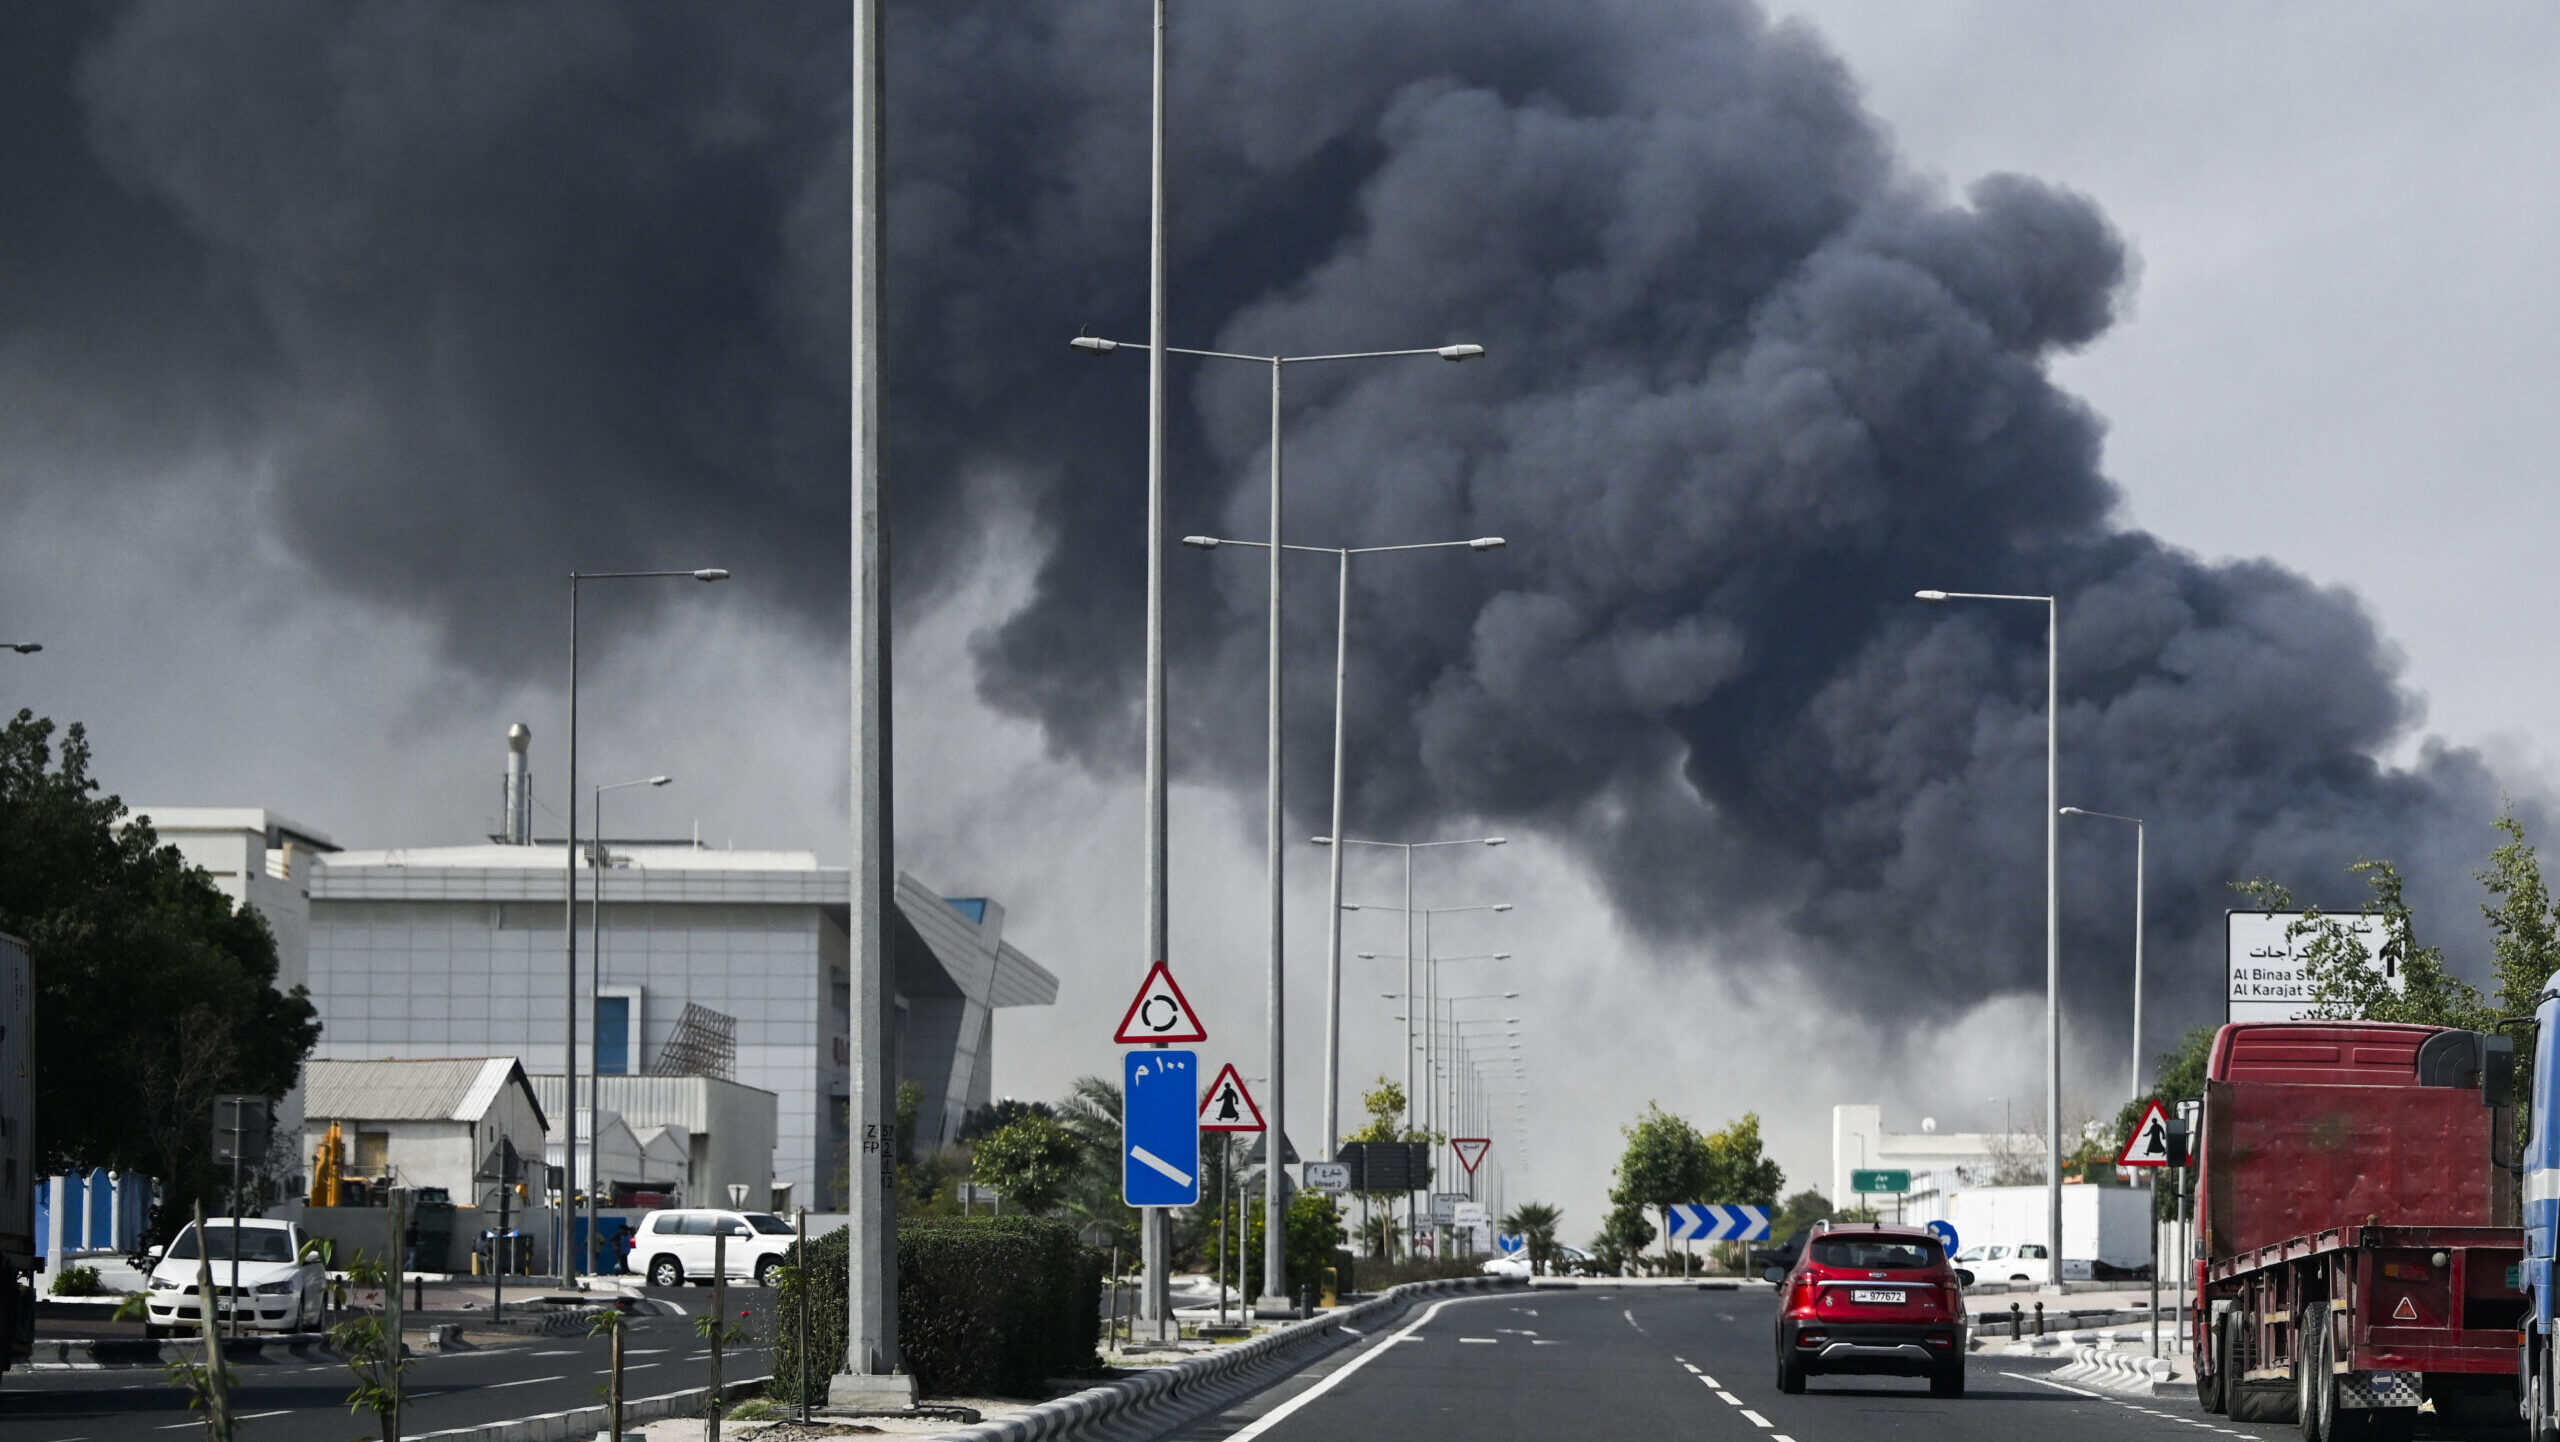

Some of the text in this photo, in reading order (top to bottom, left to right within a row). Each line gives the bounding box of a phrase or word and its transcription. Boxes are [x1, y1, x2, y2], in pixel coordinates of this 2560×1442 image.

[2234, 968, 2247, 980] Al
[2253, 968, 2291, 980] Binaa
[2234, 984, 2247, 995] Al
[2253, 984, 2302, 997] Karajat
[867, 1124, 876, 1138] Z
[863, 1141, 890, 1154] FP 2
